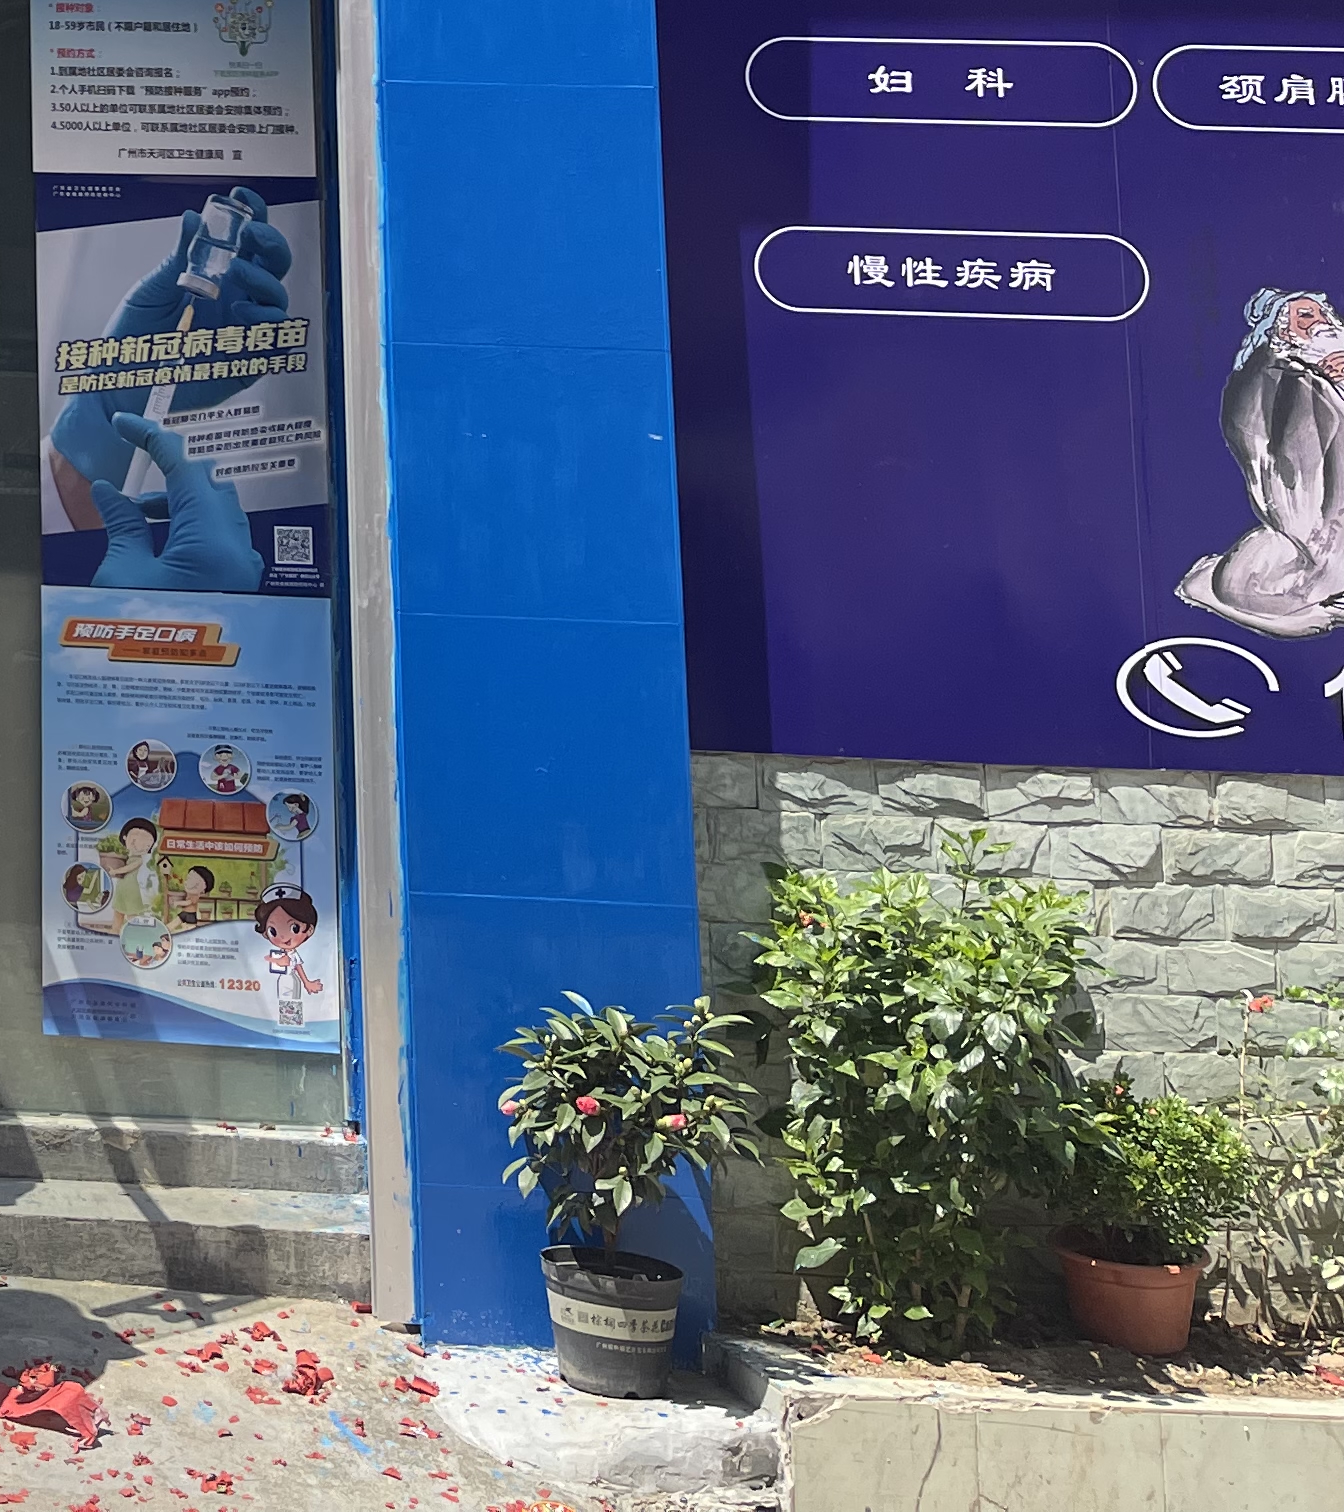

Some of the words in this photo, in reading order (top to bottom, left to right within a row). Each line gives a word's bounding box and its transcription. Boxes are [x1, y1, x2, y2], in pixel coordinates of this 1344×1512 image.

[866, 64, 1015, 99] 妇科
[845, 253, 1057, 293] 慢性疾病
[56, 319, 310, 372] 接种新冠病毒疫苗
[58, 353, 308, 396] 是防控新冠疫情最有效的手段
[72, 622, 199, 644] 预防手足口病
[218, 977, 261, 992] 12320
